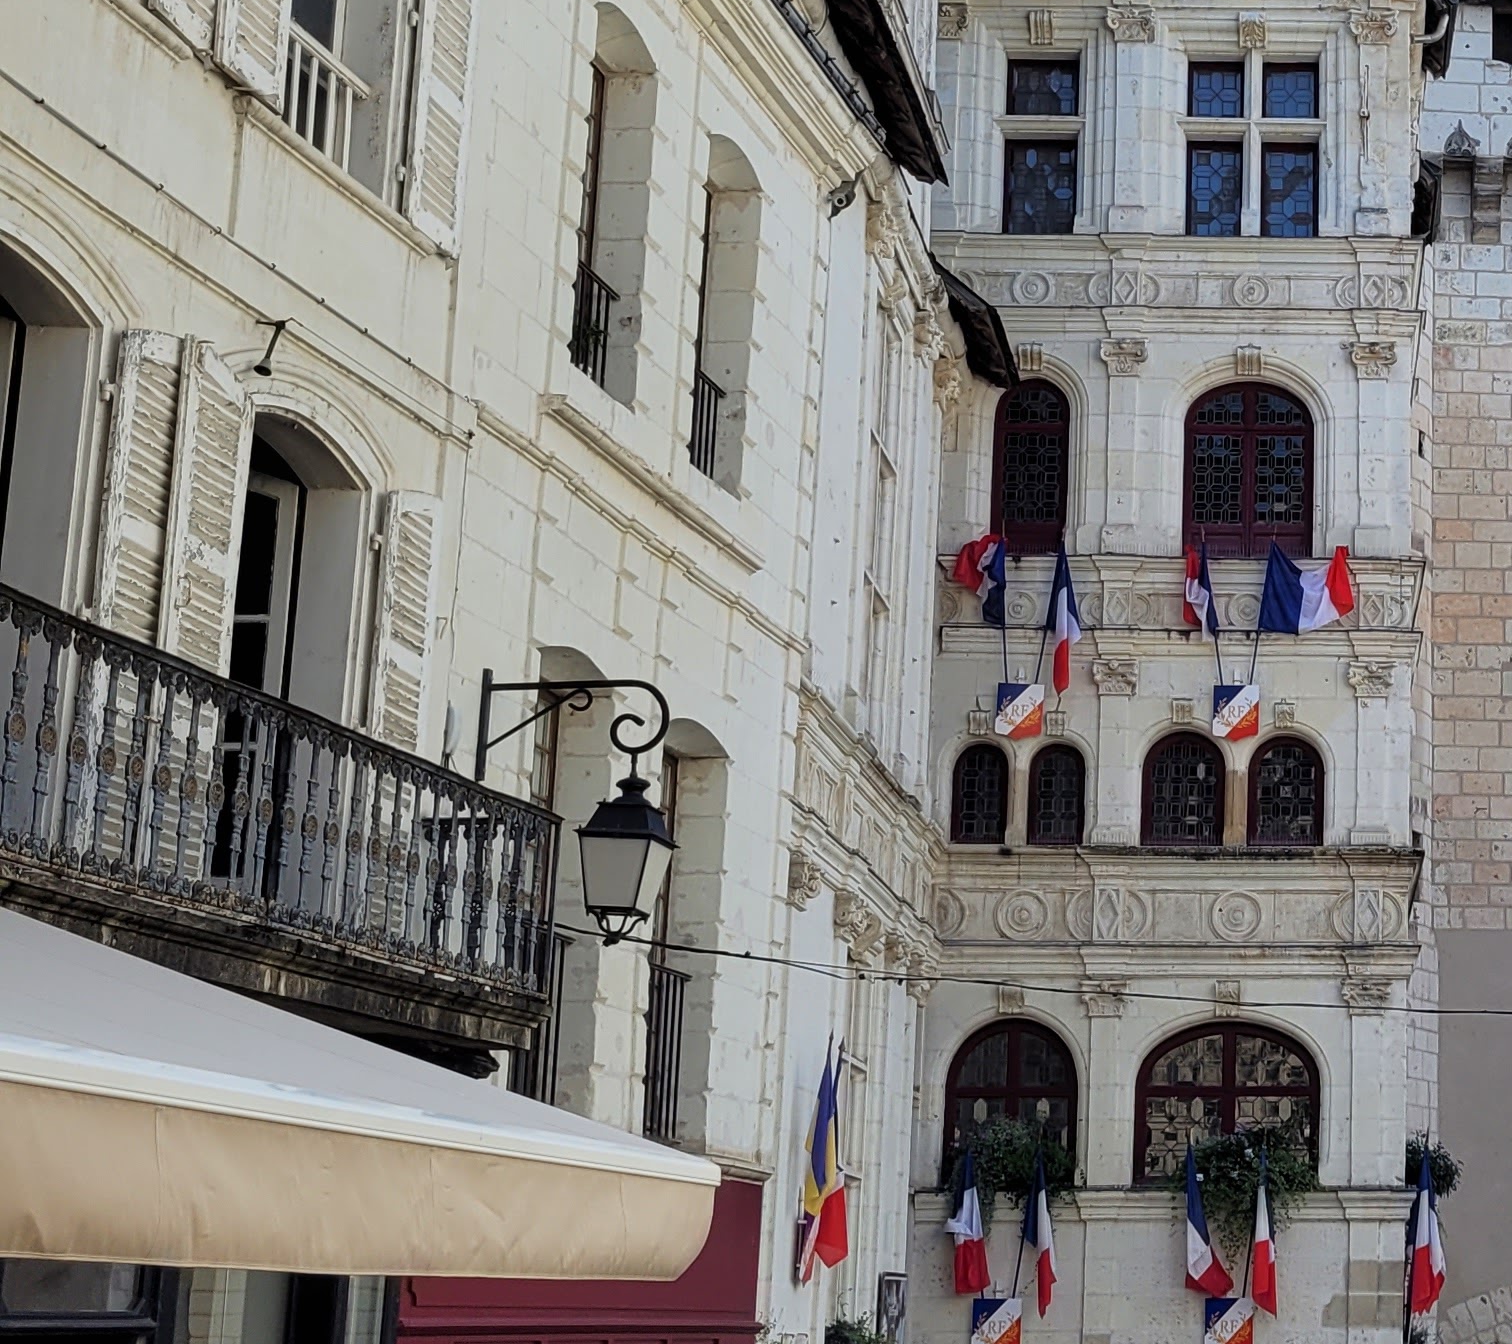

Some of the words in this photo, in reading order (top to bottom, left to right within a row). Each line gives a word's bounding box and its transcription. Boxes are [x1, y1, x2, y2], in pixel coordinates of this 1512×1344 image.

[1011, 704, 1029, 716] RF
[1228, 705, 1245, 718] RF
[988, 1320, 1006, 1334] RF
[1221, 1320, 1238, 1333] RF
